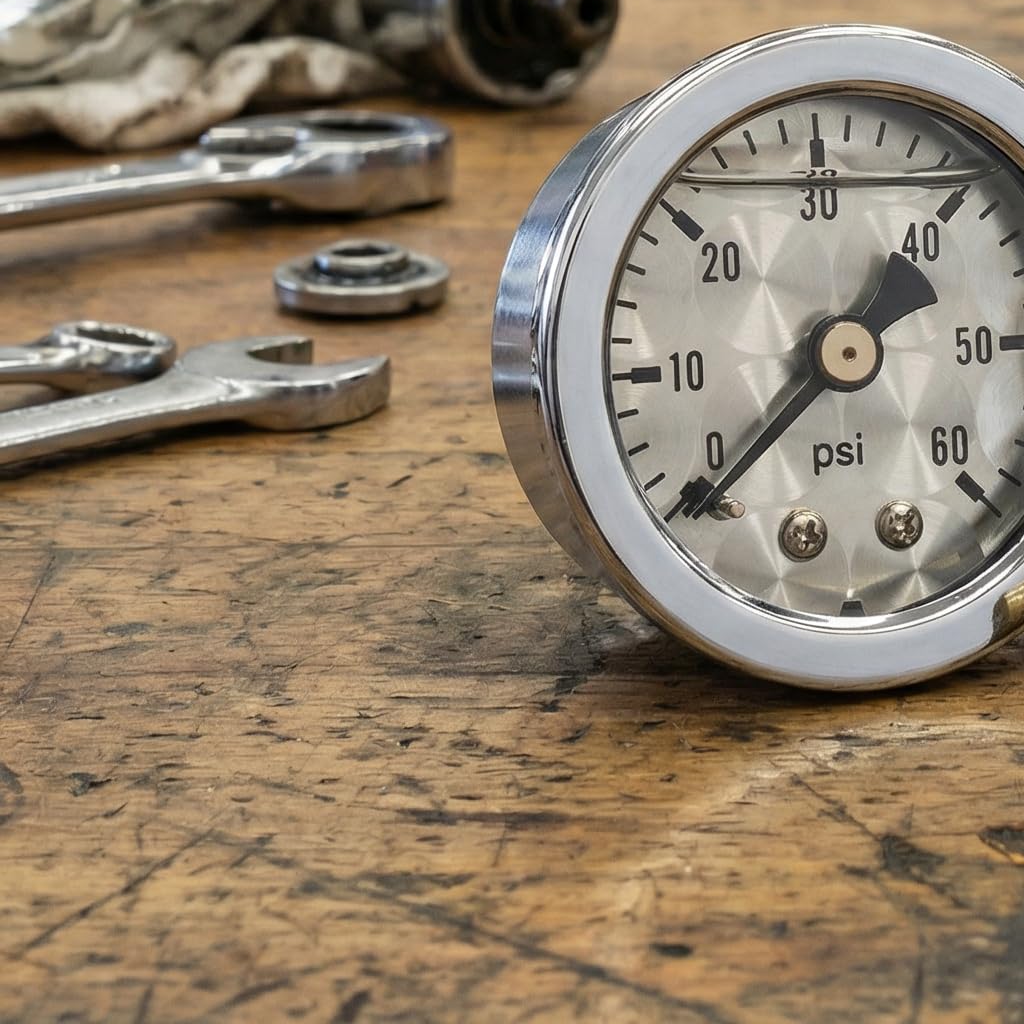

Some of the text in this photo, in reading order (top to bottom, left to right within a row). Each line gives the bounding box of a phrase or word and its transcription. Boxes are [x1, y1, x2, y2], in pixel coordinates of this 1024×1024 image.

[800, 187, 838, 221] 30
[701, 241, 741, 282] 20
[901, 221, 940, 262] 40
[955, 326, 993, 366] 50
[669, 350, 704, 392] 10
[706, 431, 725, 471] 0
[812, 432, 864, 475] psi
[931, 424, 969, 466] 60
